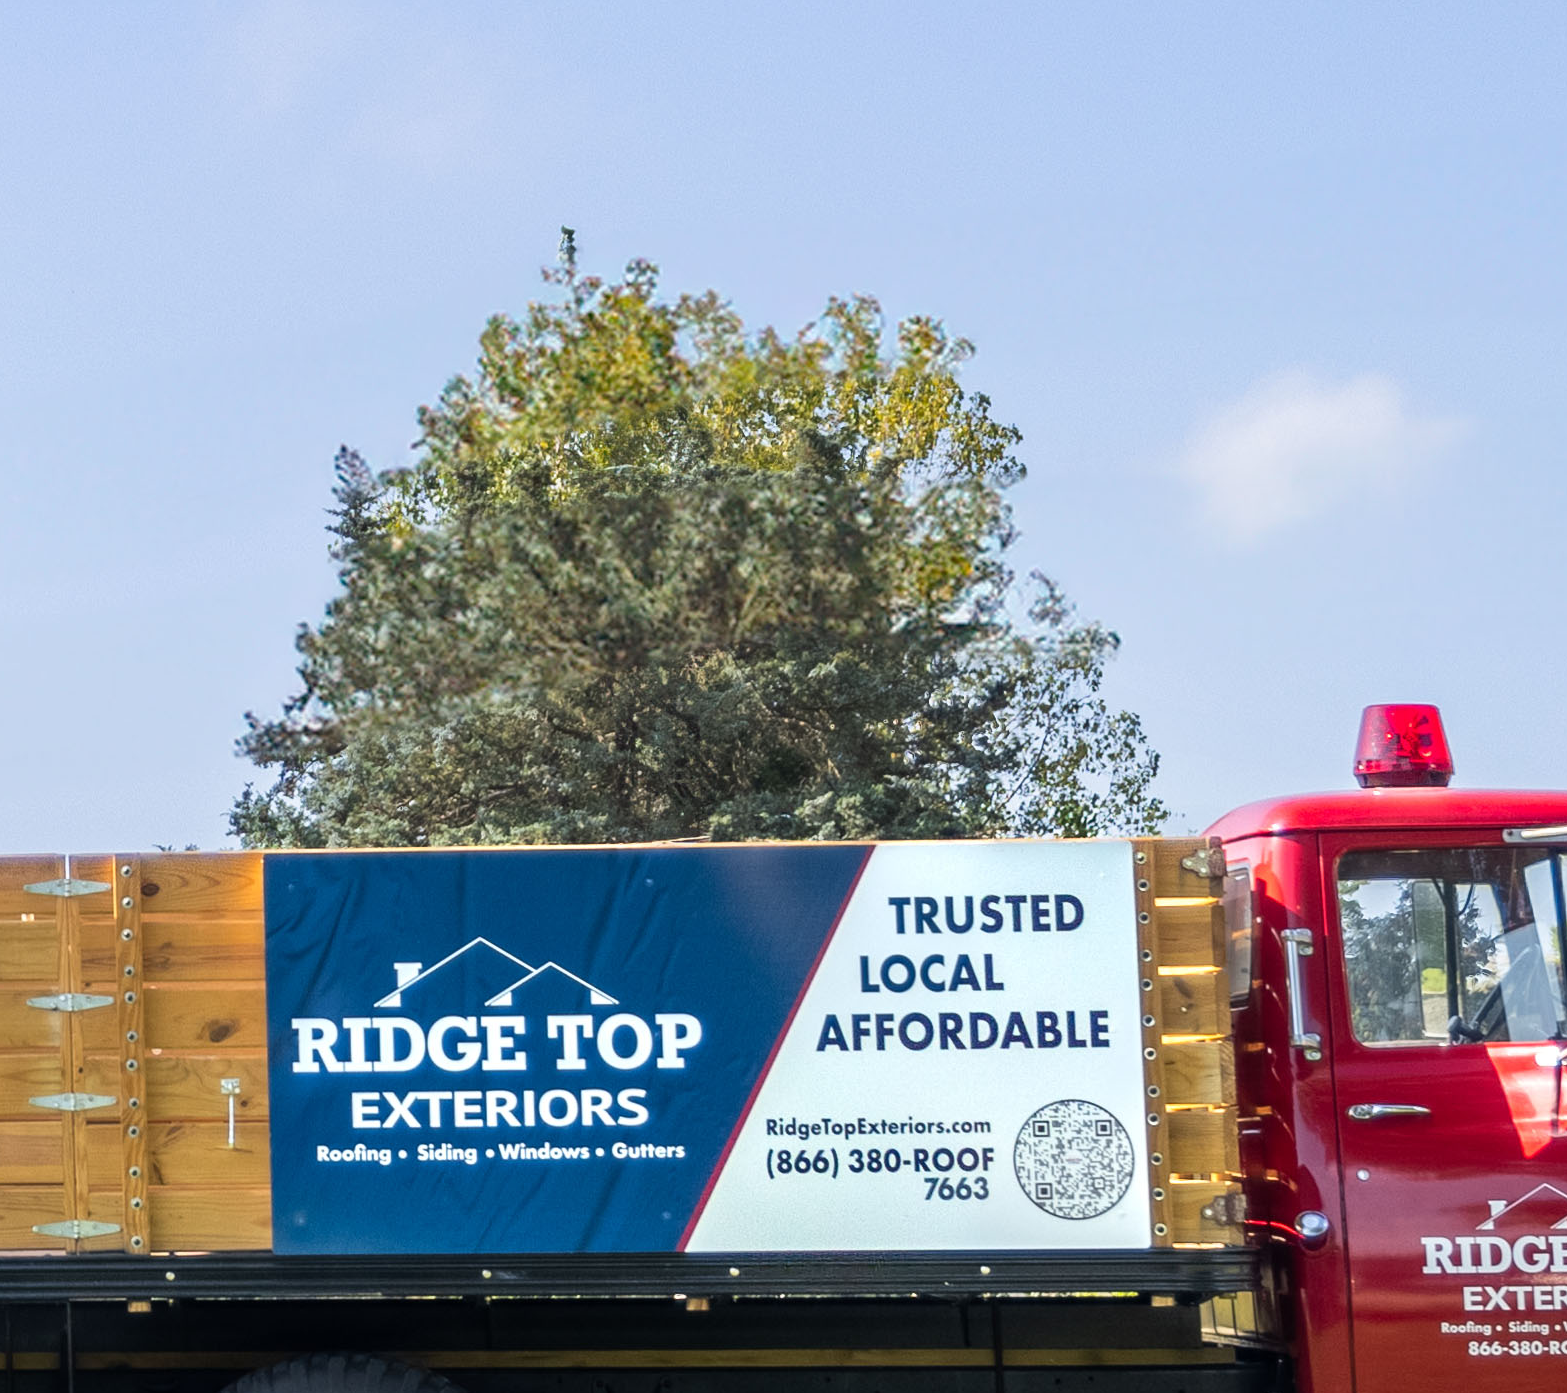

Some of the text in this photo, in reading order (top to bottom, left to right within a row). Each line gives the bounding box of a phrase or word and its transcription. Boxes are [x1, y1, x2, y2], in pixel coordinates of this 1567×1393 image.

[889, 895, 1084, 934] TRUSTED
[860, 954, 1004, 993] LOCAL
[292, 1014, 702, 1072] RIDGE TOP
[817, 1011, 1109, 1051] AFFORDABLE
[352, 1089, 648, 1128] EXTERIORS
[767, 1117, 990, 1140] RidgeTopExteriors.com
[317, 1142, 685, 1165] Roofing Siding Windows Gutters
[767, 1148, 994, 1179] (866) 380-ROOF
[924, 1177, 989, 1200] 7663
[1441, 1321, 1491, 1335] Roofing
[1509, 1321, 1549, 1335] Siding
